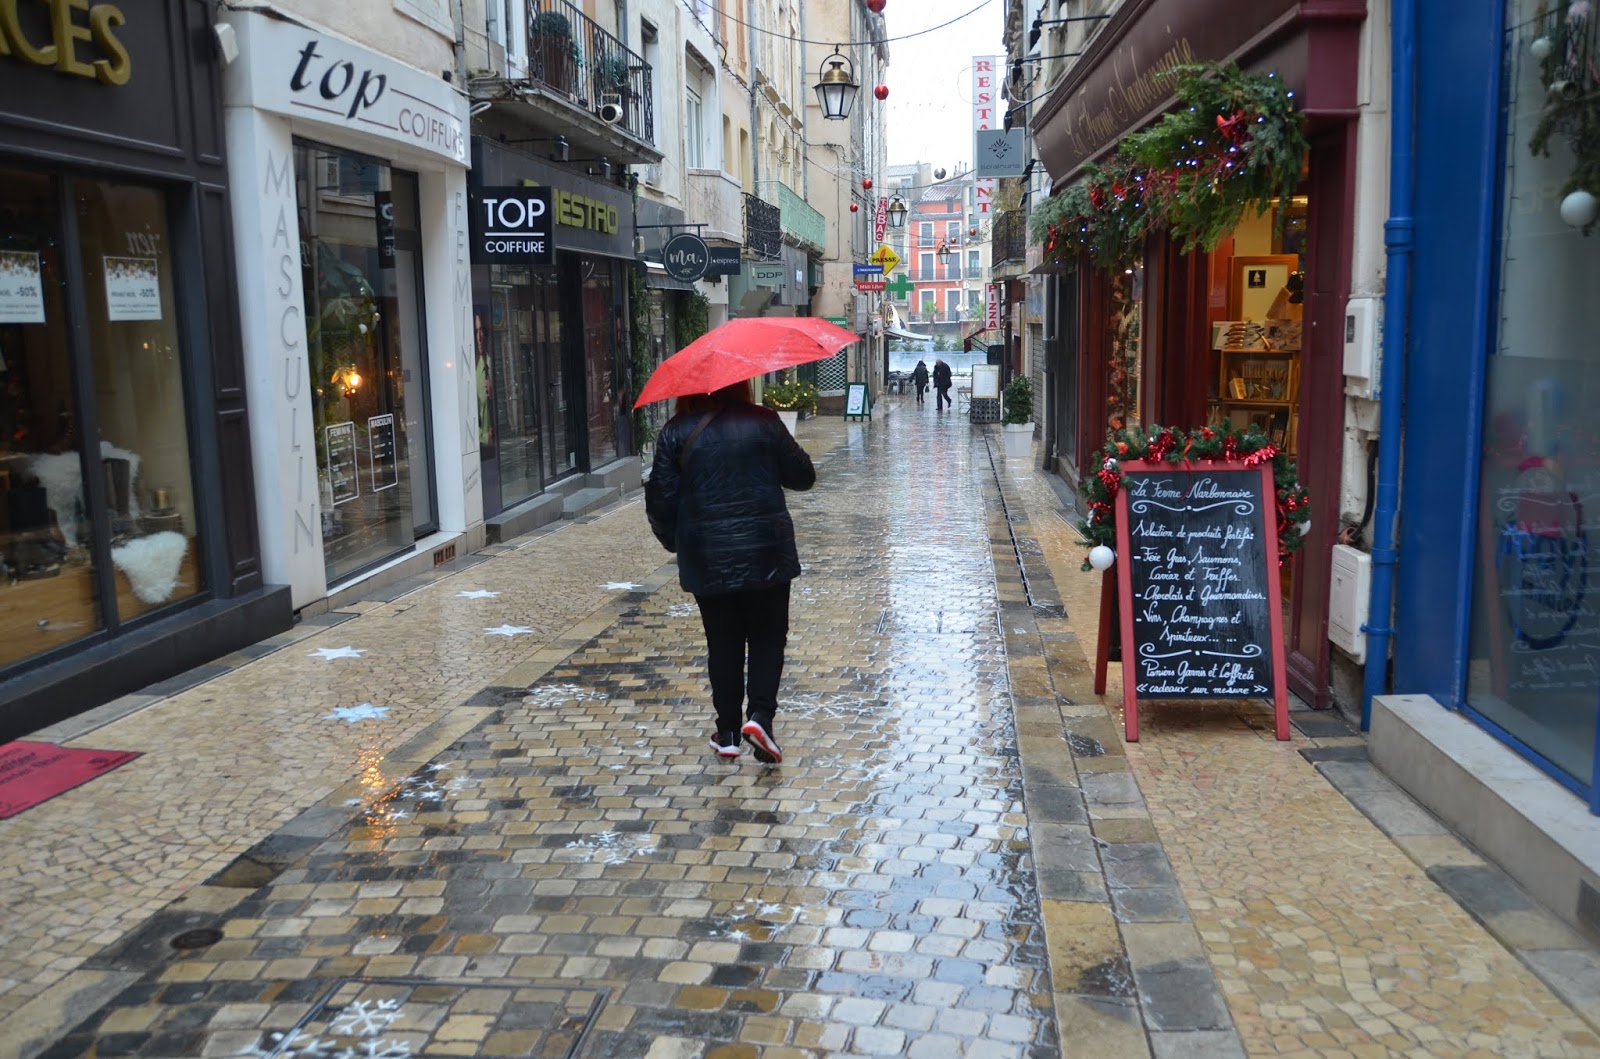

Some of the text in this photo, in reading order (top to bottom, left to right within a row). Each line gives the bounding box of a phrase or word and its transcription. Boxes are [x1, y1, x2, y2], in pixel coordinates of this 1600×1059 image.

[0, 0, 131, 85] CES
[290, 40, 387, 119] top
[399, 108, 465, 155] COIFFURE
[483, 198, 545, 228] TOP
[875, 197, 888, 241] TABAC
[485, 241, 545, 253] COIFFURE
[757, 271, 783, 279] DDP
[988, 285, 998, 328] PIZZA
[264, 149, 315, 554] MASCULIN
[1131, 478, 1254, 498] La Ferme Narbonnaise
[1176, 524, 1187, 538] de
[1187, 525, 1221, 545] produits
[1148, 565, 1180, 581] Caviar
[1184, 567, 1196, 581] et
[1185, 585, 1197, 601] et
[1230, 610, 1241, 624] et
[1208, 663, 1218, 679] et
[1218, 662, 1255, 686] Coffrets
[1149, 680, 1189, 693] cadeaux
[1190, 685, 1209, 695] sur
[1212, 686, 1250, 695] mesure
